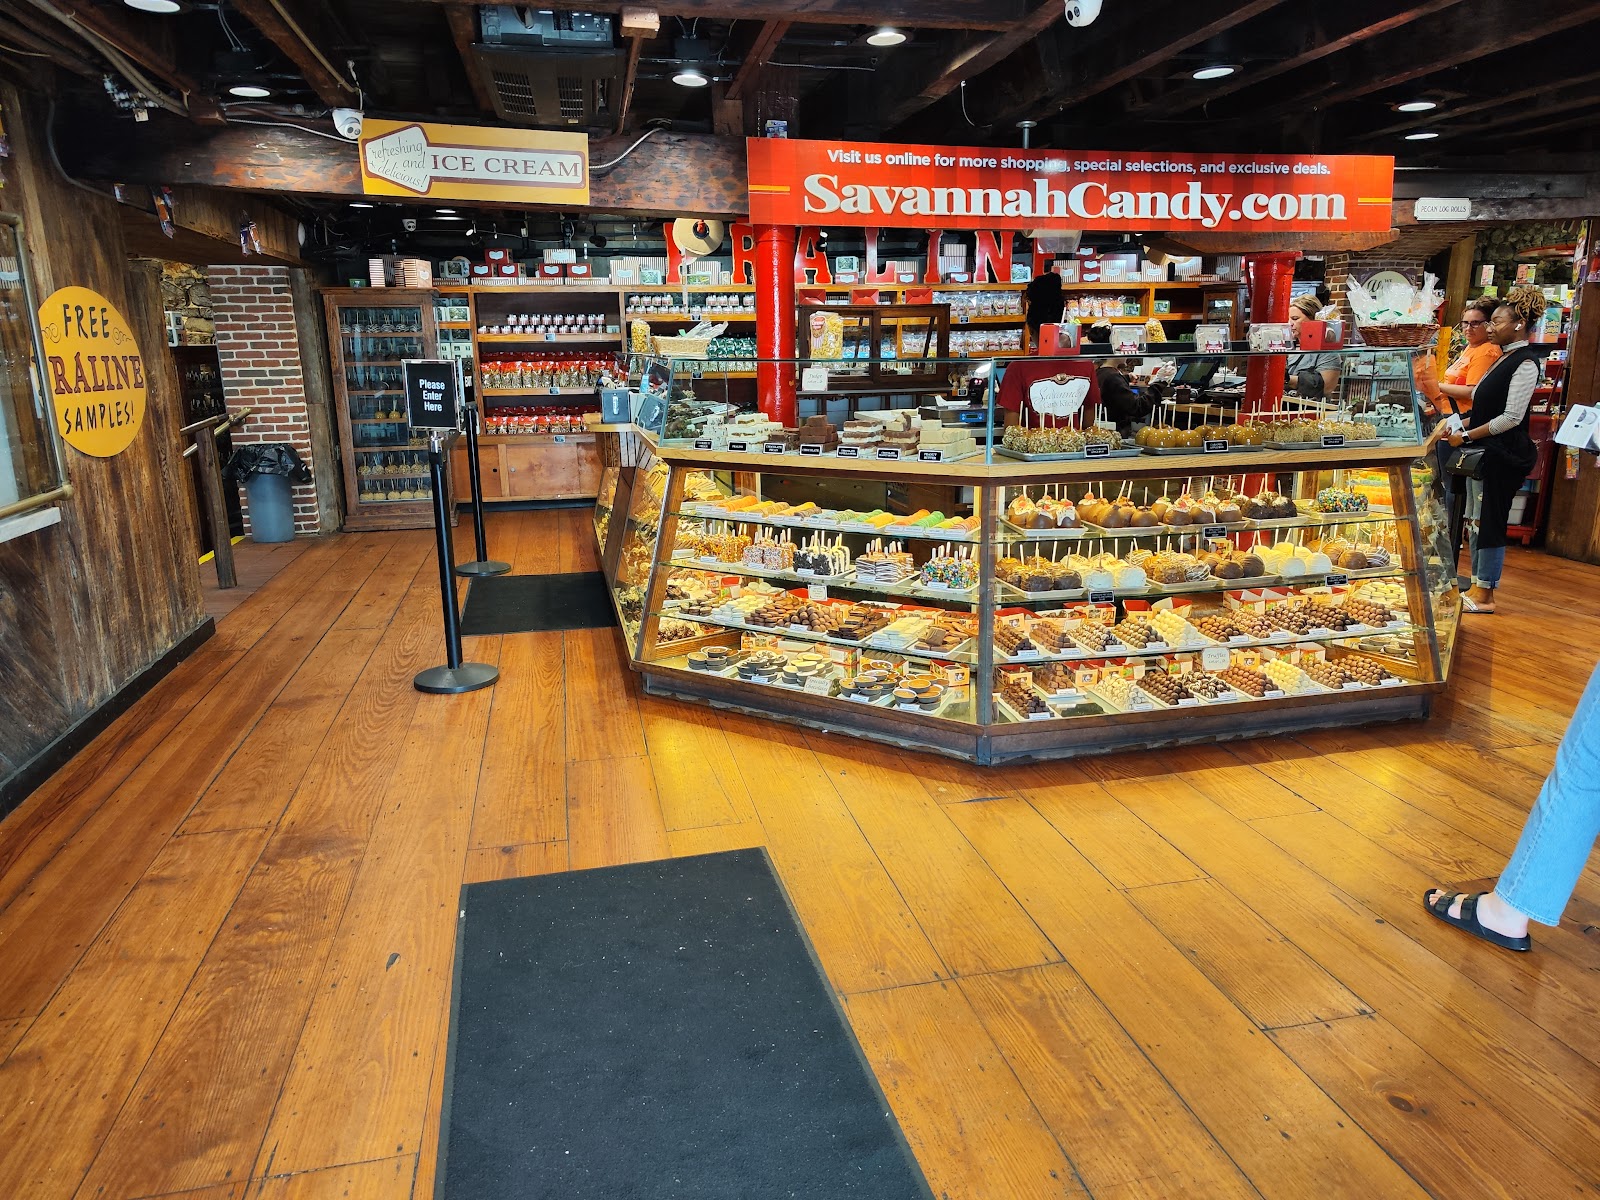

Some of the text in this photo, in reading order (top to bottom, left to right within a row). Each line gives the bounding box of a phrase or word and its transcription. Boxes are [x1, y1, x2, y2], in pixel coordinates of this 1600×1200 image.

[370, 136, 423, 162] refreshing
[402, 151, 426, 169] and
[827, 149, 1331, 175] Visit us online for more shopping, special selections, and exclusive deals.
[377, 159, 428, 188] delicious!
[431, 155, 580, 178] ICE CREAM
[803, 173, 1347, 228] SavannahCandy.com
[1421, 205, 1467, 213] PECAN LOG ROLLS
[62, 303, 110, 339] FREE
[31, 351, 144, 395] RALINE
[419, 379, 445, 390] Please
[422, 390, 442, 401] Enter
[424, 401, 442, 412] Here
[63, 400, 135, 435] SAMPLES!
